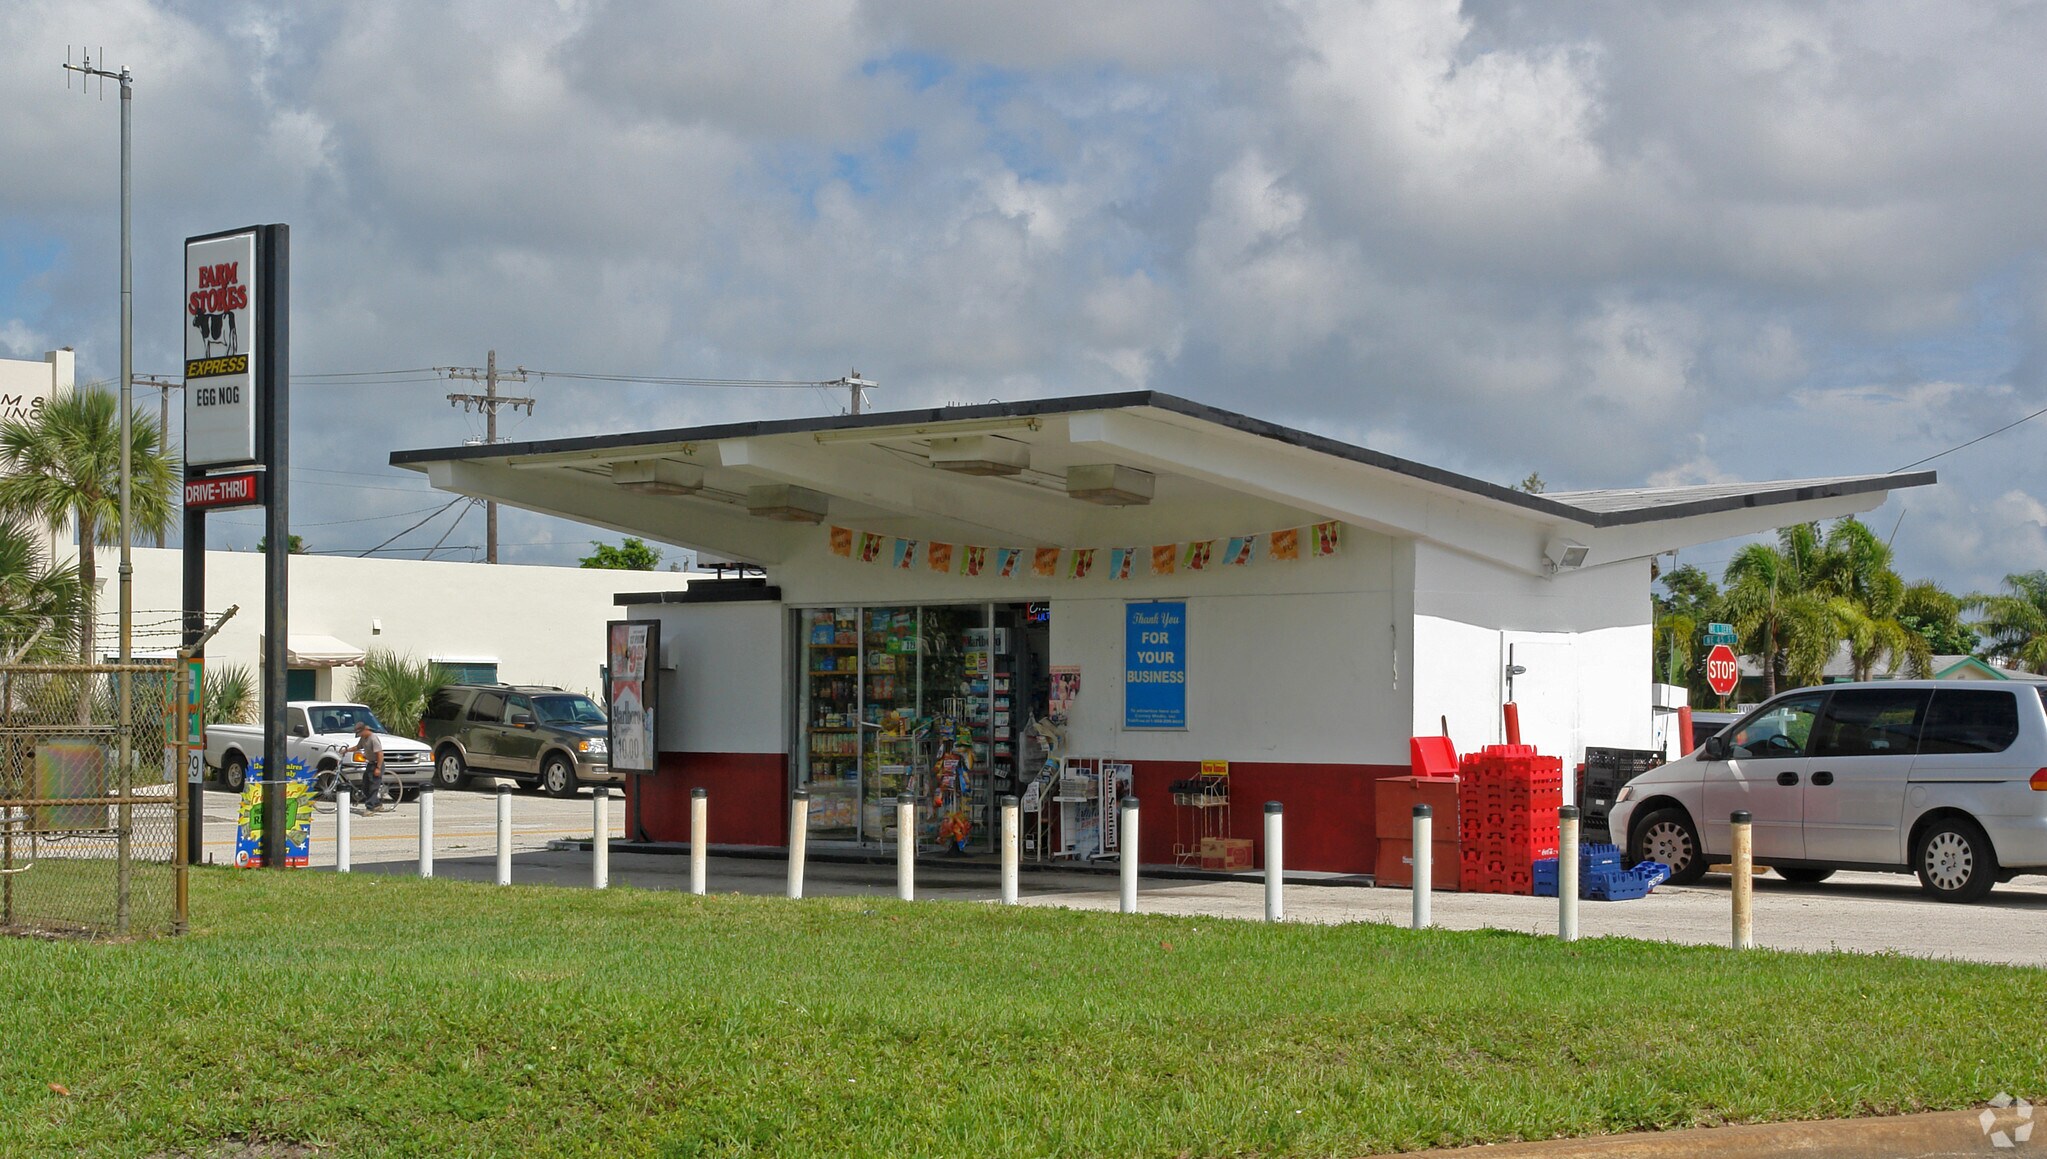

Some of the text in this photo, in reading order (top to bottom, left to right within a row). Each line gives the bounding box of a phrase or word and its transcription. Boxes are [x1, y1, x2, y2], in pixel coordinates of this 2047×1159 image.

[198, 262, 239, 288] FARM
[188, 284, 248, 315] STORES
[187, 356, 246, 377] EXPRESS
[196, 386, 240, 407] EGG NOG
[185, 479, 248, 503] DRIVE-THRU
[1132, 611, 1180, 628] Thank You
[1141, 632, 1169, 644] FOR
[1137, 651, 1175, 664] YOUR
[1127, 670, 1185, 683] BUSINESS
[1709, 660, 1736, 679] STOP
[1647, 872, 1664, 889] PEPSI
